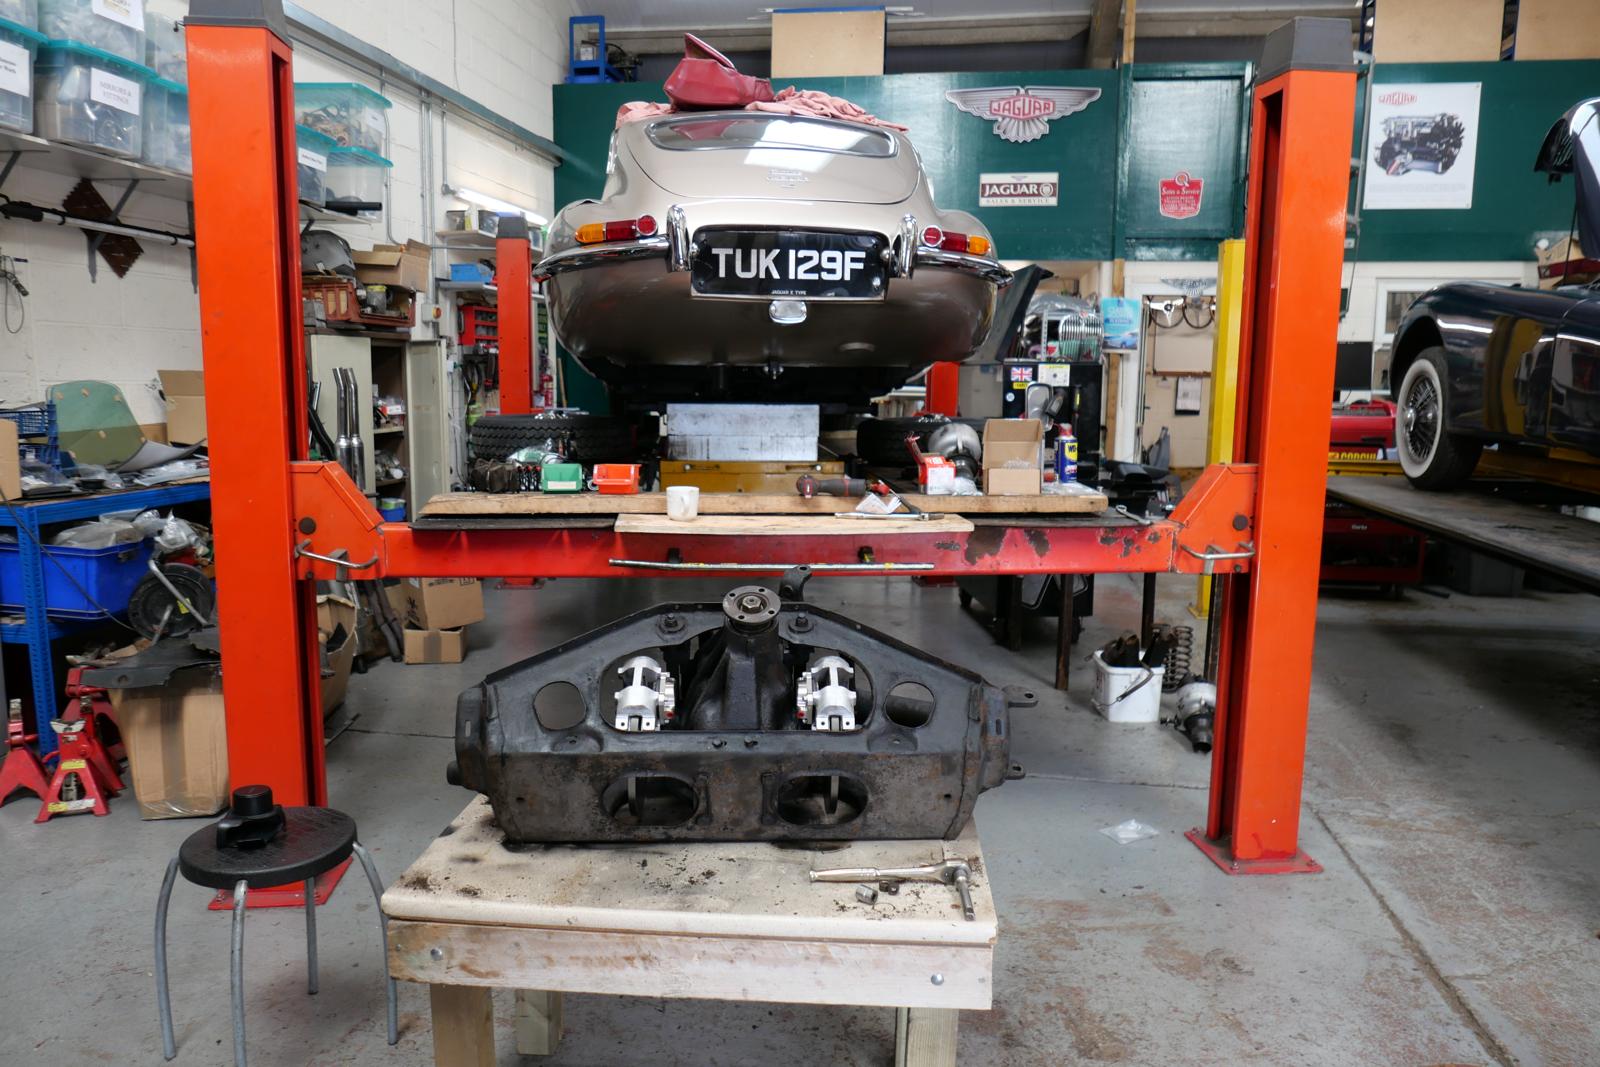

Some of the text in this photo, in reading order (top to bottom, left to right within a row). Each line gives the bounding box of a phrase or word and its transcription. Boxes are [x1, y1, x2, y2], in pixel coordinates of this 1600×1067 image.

[992, 96, 1052, 116] JAGUAR
[984, 184, 1038, 196] JAGUAR
[711, 247, 866, 281] TUK 129F
